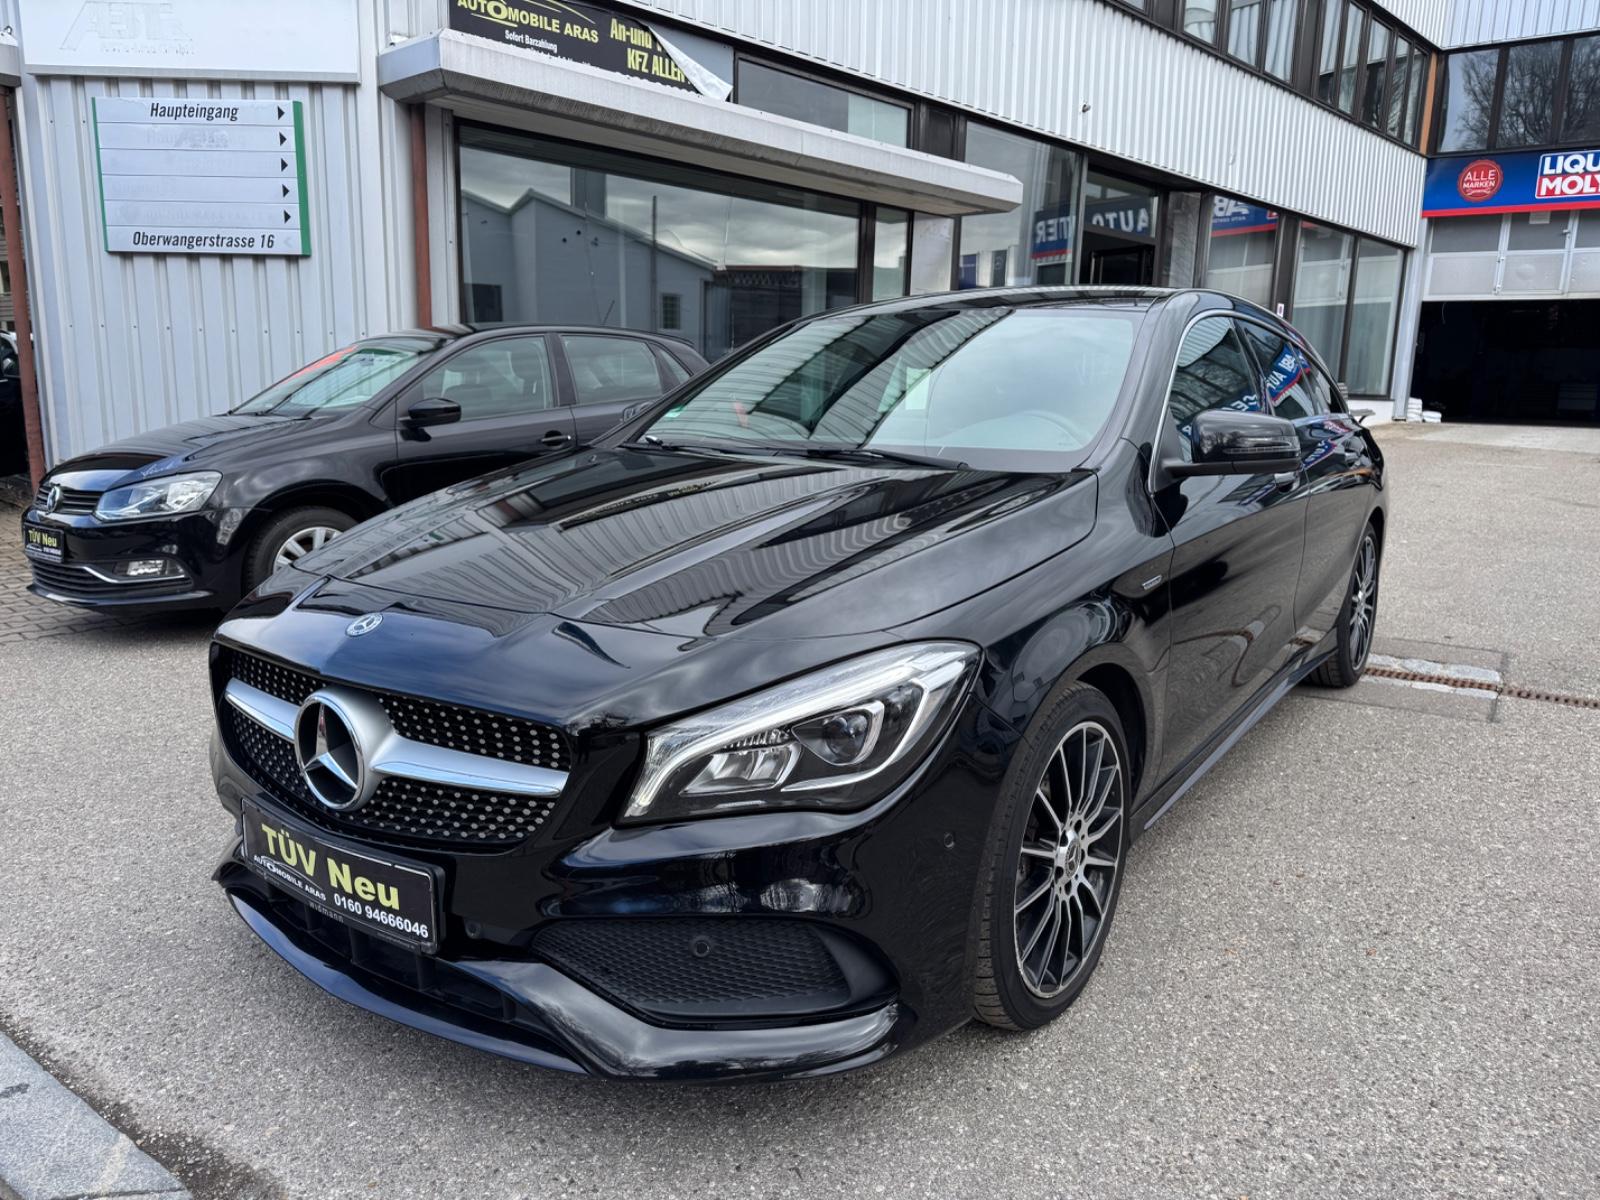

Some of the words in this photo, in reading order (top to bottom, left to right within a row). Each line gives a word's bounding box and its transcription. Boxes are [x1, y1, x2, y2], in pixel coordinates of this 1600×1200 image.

[457, 0, 560, 33] AUTOMOBILE
[564, 22, 599, 44] ARAS
[504, 29, 525, 43] Sofort
[525, 35, 558, 53] Barzahlung
[627, 47, 649, 73] KFZ
[150, 103, 239, 122] Haupteingang
[1463, 180, 1496, 189] MARKEN
[1464, 169, 1496, 182] ALLE
[132, 231, 255, 249] Oberwangerstrasse
[260, 234, 275, 249] 16
[42, 532, 57, 548] Neu
[254, 854, 304, 889] AUTOMOBILE
[305, 884, 326, 901] ARAS
[261, 823, 316, 877] TÜV
[327, 857, 399, 910] Neu
[334, 893, 362, 915] 0160
[365, 905, 429, 938] 94666046
